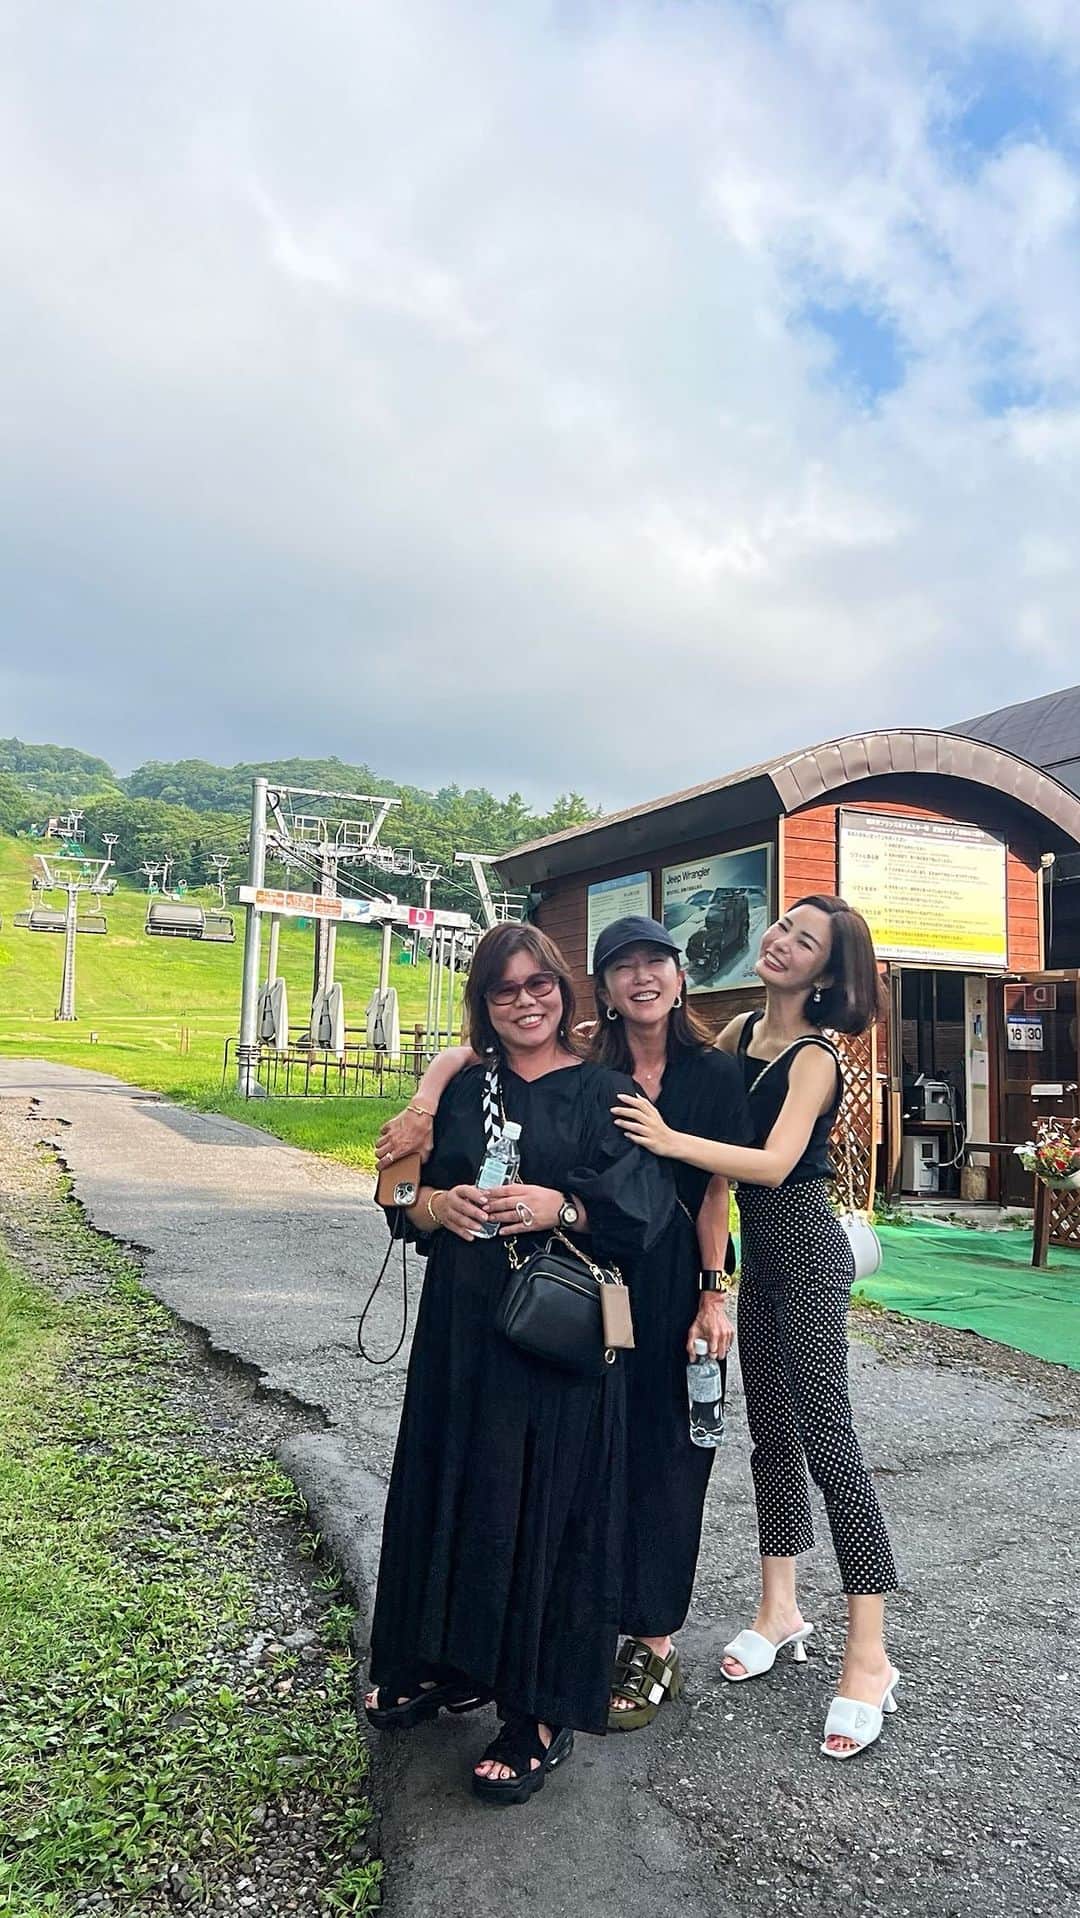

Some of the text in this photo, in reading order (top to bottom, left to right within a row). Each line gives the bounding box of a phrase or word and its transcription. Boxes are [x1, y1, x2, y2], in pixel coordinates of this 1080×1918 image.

[666, 866, 710, 885] Jeep Wrangler
[416, 911, 427, 923] D
